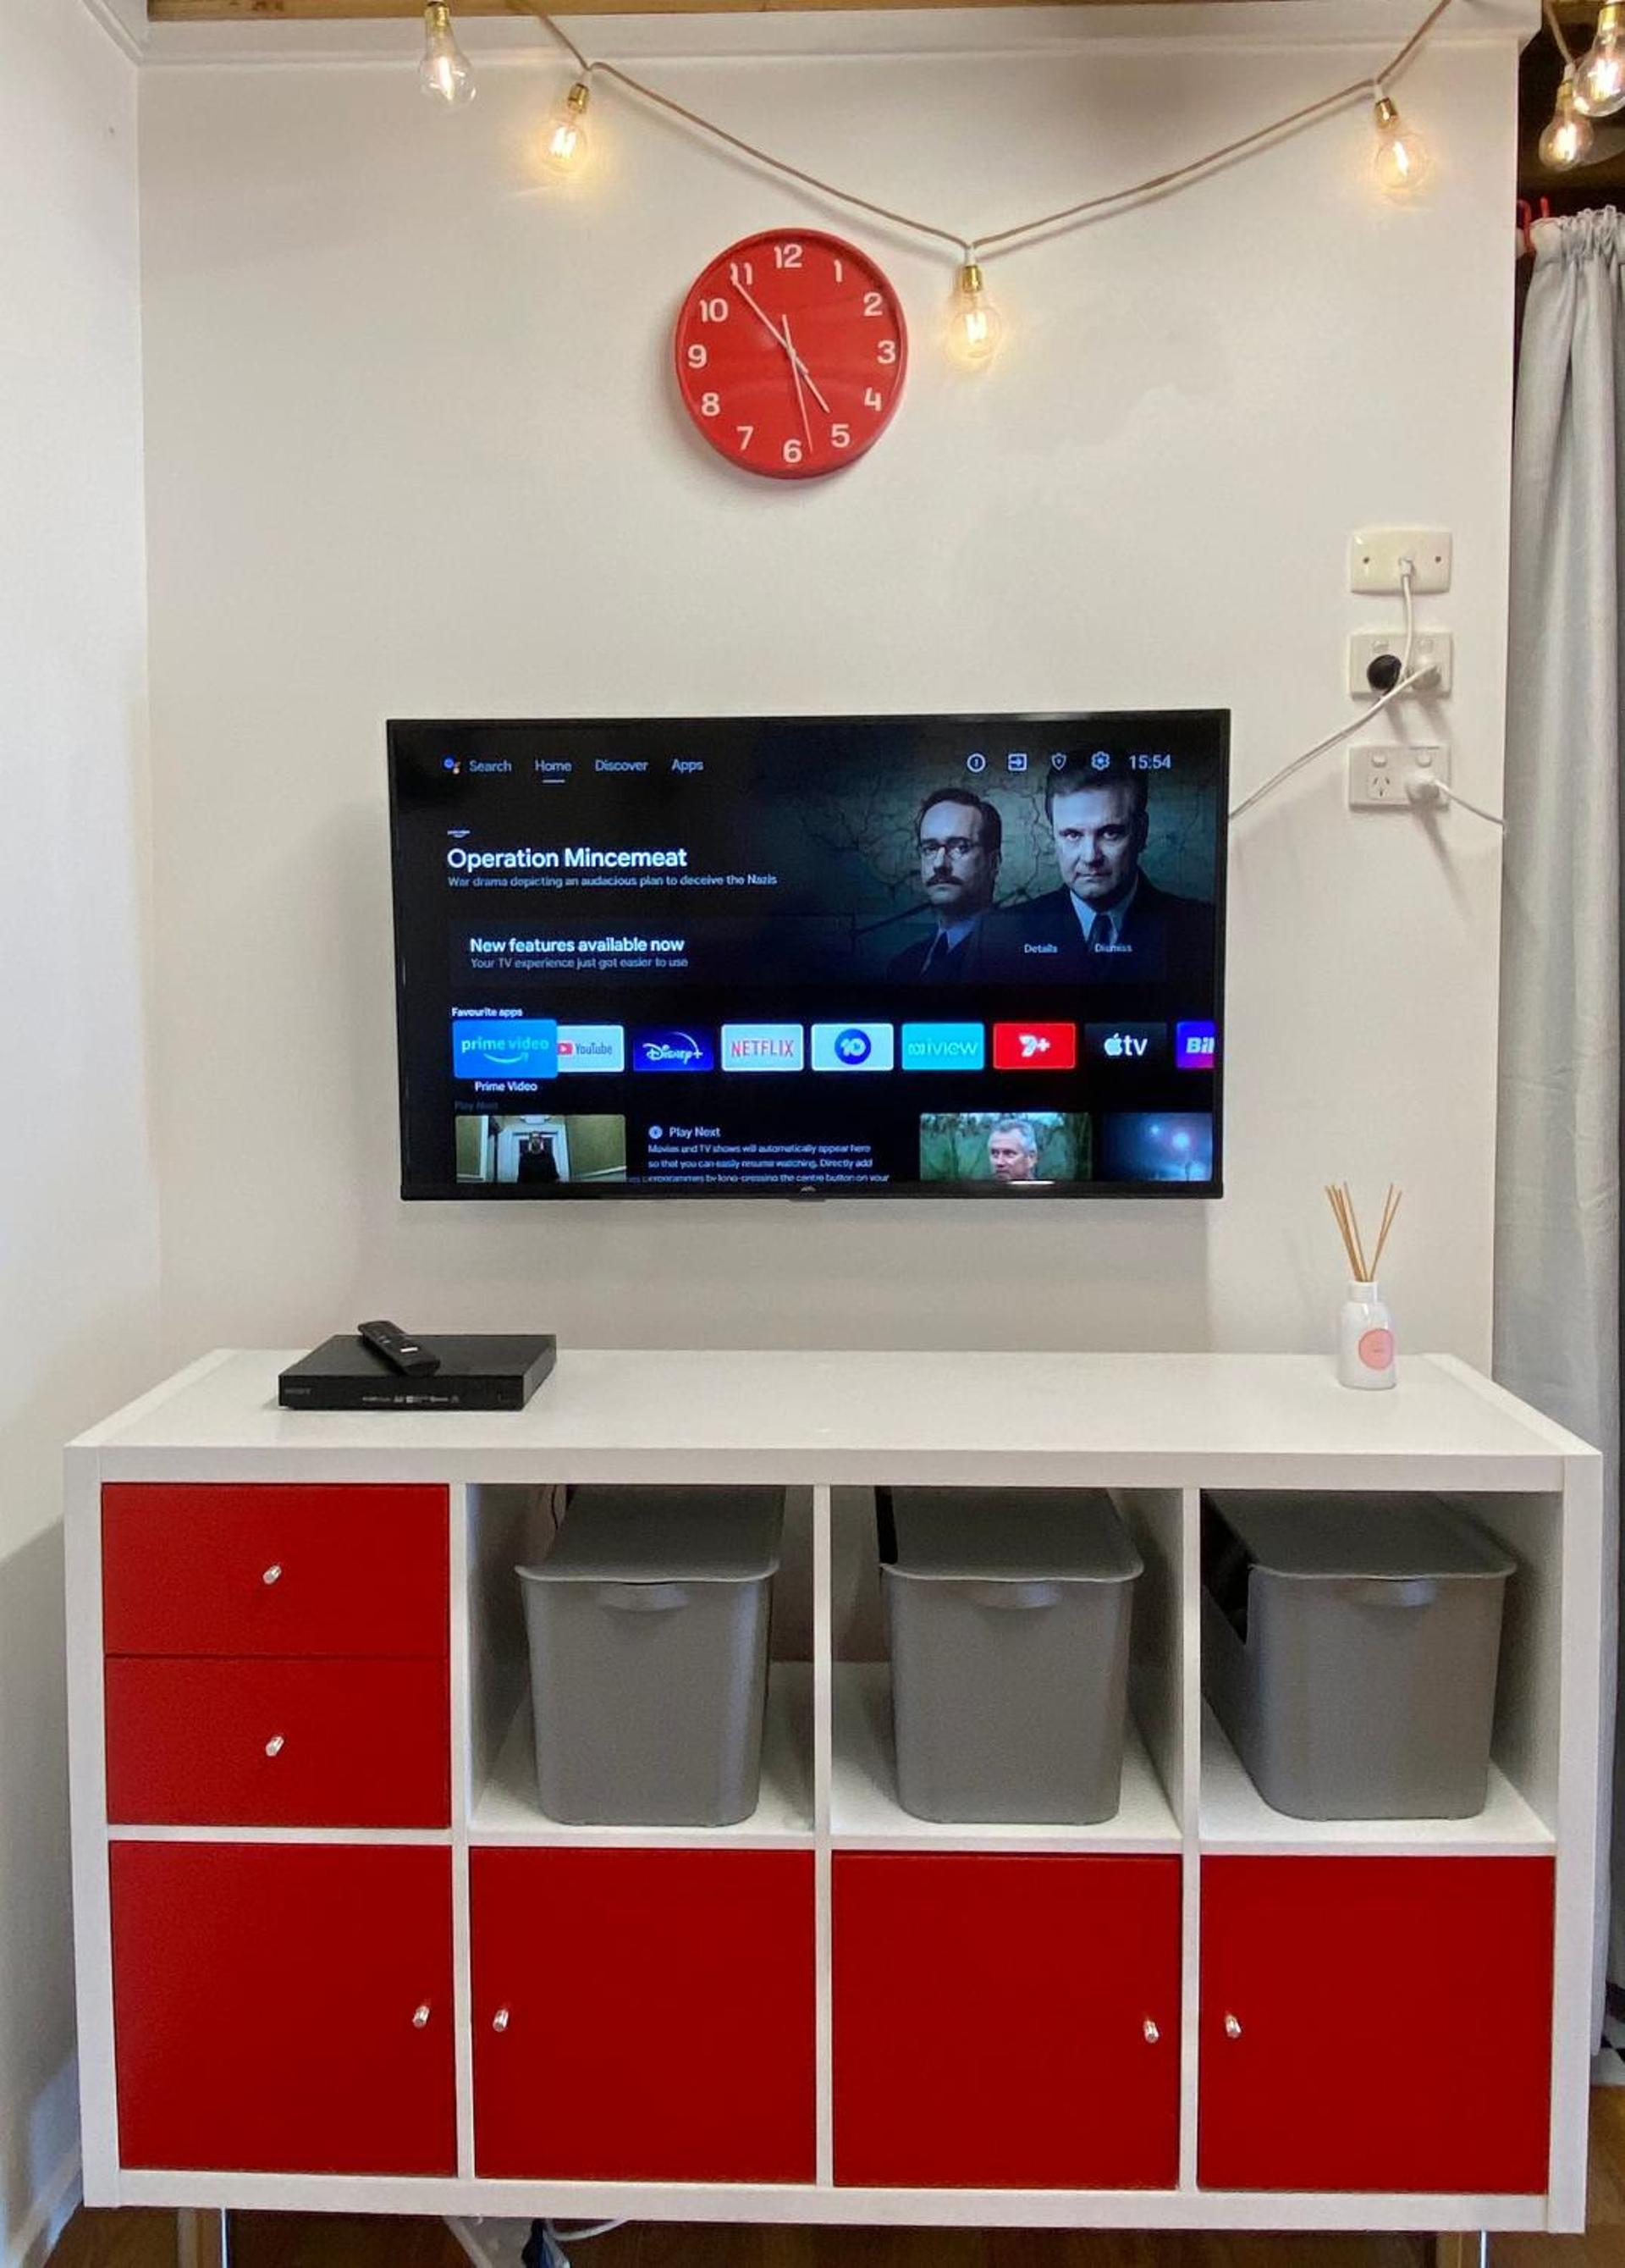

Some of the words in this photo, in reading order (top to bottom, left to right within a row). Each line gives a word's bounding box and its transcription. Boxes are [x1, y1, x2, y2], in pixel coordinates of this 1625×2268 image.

[774, 244, 803, 268] 12
[730, 262, 753, 285] 11
[834, 259, 843, 284] 1
[700, 298, 729, 323] 10
[863, 292, 883, 317] 2
[687, 344, 707, 369] 9
[877, 339, 896, 364] 3
[701, 392, 720, 417] 8
[864, 387, 882, 411] 4
[736, 425, 754, 451] 7
[831, 423, 851, 449] 5
[783, 439, 802, 463] 6
[469, 759, 512, 772] Search
[535, 759, 572, 772] Home
[595, 759, 649, 772] Discover
[671, 759, 704, 773] Apps
[1129, 754, 1171, 770] 15:54
[447, 847, 559, 873] Operation
[565, 847, 688, 868] Mincemeat
[448, 876, 470, 887] War
[472, 876, 508, 887] drama
[510, 875, 563, 888] depicting
[565, 878, 579, 886] an
[581, 875, 636, 886] audacious
[639, 875, 664, 887] plan
[666, 875, 678, 886] to
[680, 875, 724, 886] deceive
[726, 875, 745, 886] the
[747, 874, 778, 886] Nazis
[470, 938, 506, 952] New
[509, 937, 576, 952] features
[578, 936, 647, 952] available
[650, 939, 686, 952] now
[1024, 943, 1058, 953] Details
[471, 957, 495, 968] Your
[499, 957, 512, 968] TV
[515, 957, 575, 970] experience
[576, 957, 597, 970] just
[598, 957, 618, 970] got
[620, 957, 653, 968] easier
[655, 957, 666, 967] to
[669, 957, 688, 967] use
[451, 1007, 498, 1018] Favourite
[499, 1008, 523, 1019] apps
[461, 1036, 505, 1053] prime
[508, 1035, 549, 1051] video
[575, 1042, 613, 1056] YouTube
[730, 1040, 794, 1057] NETFLIX
[840, 1038, 867, 1057] 10
[1018, 1034, 1051, 1057] 7+
[1123, 1035, 1148, 1057] tv
[474, 1081, 506, 1092] Prime
[507, 1080, 538, 1092] Video
[669, 1126, 693, 1140] Play
[695, 1126, 721, 1138] Next
[741, 1144, 757, 1152] will
[758, 1144, 818, 1154] automatically
[818, 1145, 849, 1154] appear
[850, 1144, 871, 1152] here
[680, 1161, 697, 1169] you
[819, 1158, 854, 1169] Directly
[855, 1158, 873, 1167] add
